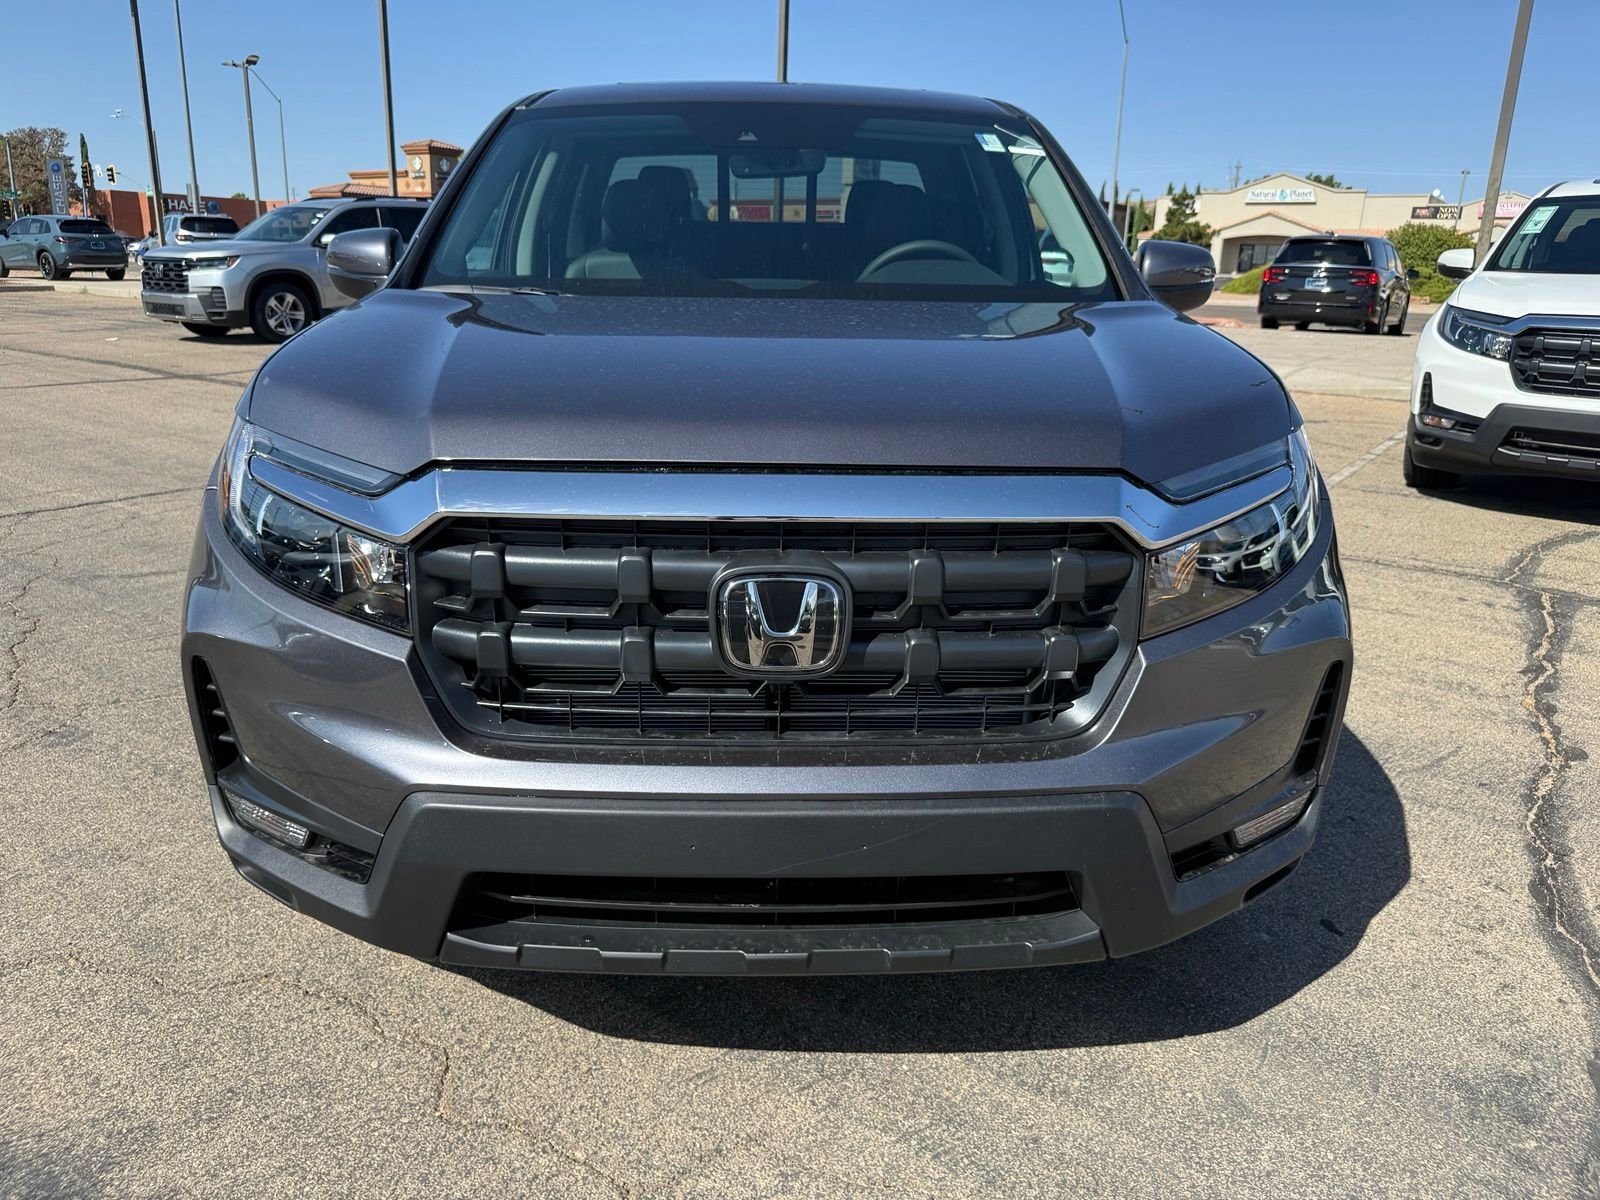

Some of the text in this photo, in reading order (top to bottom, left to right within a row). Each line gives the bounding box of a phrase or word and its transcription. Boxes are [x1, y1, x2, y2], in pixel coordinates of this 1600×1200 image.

[52, 174, 66, 214] CHASE
[1251, 189, 1312, 198] Natural Planet
